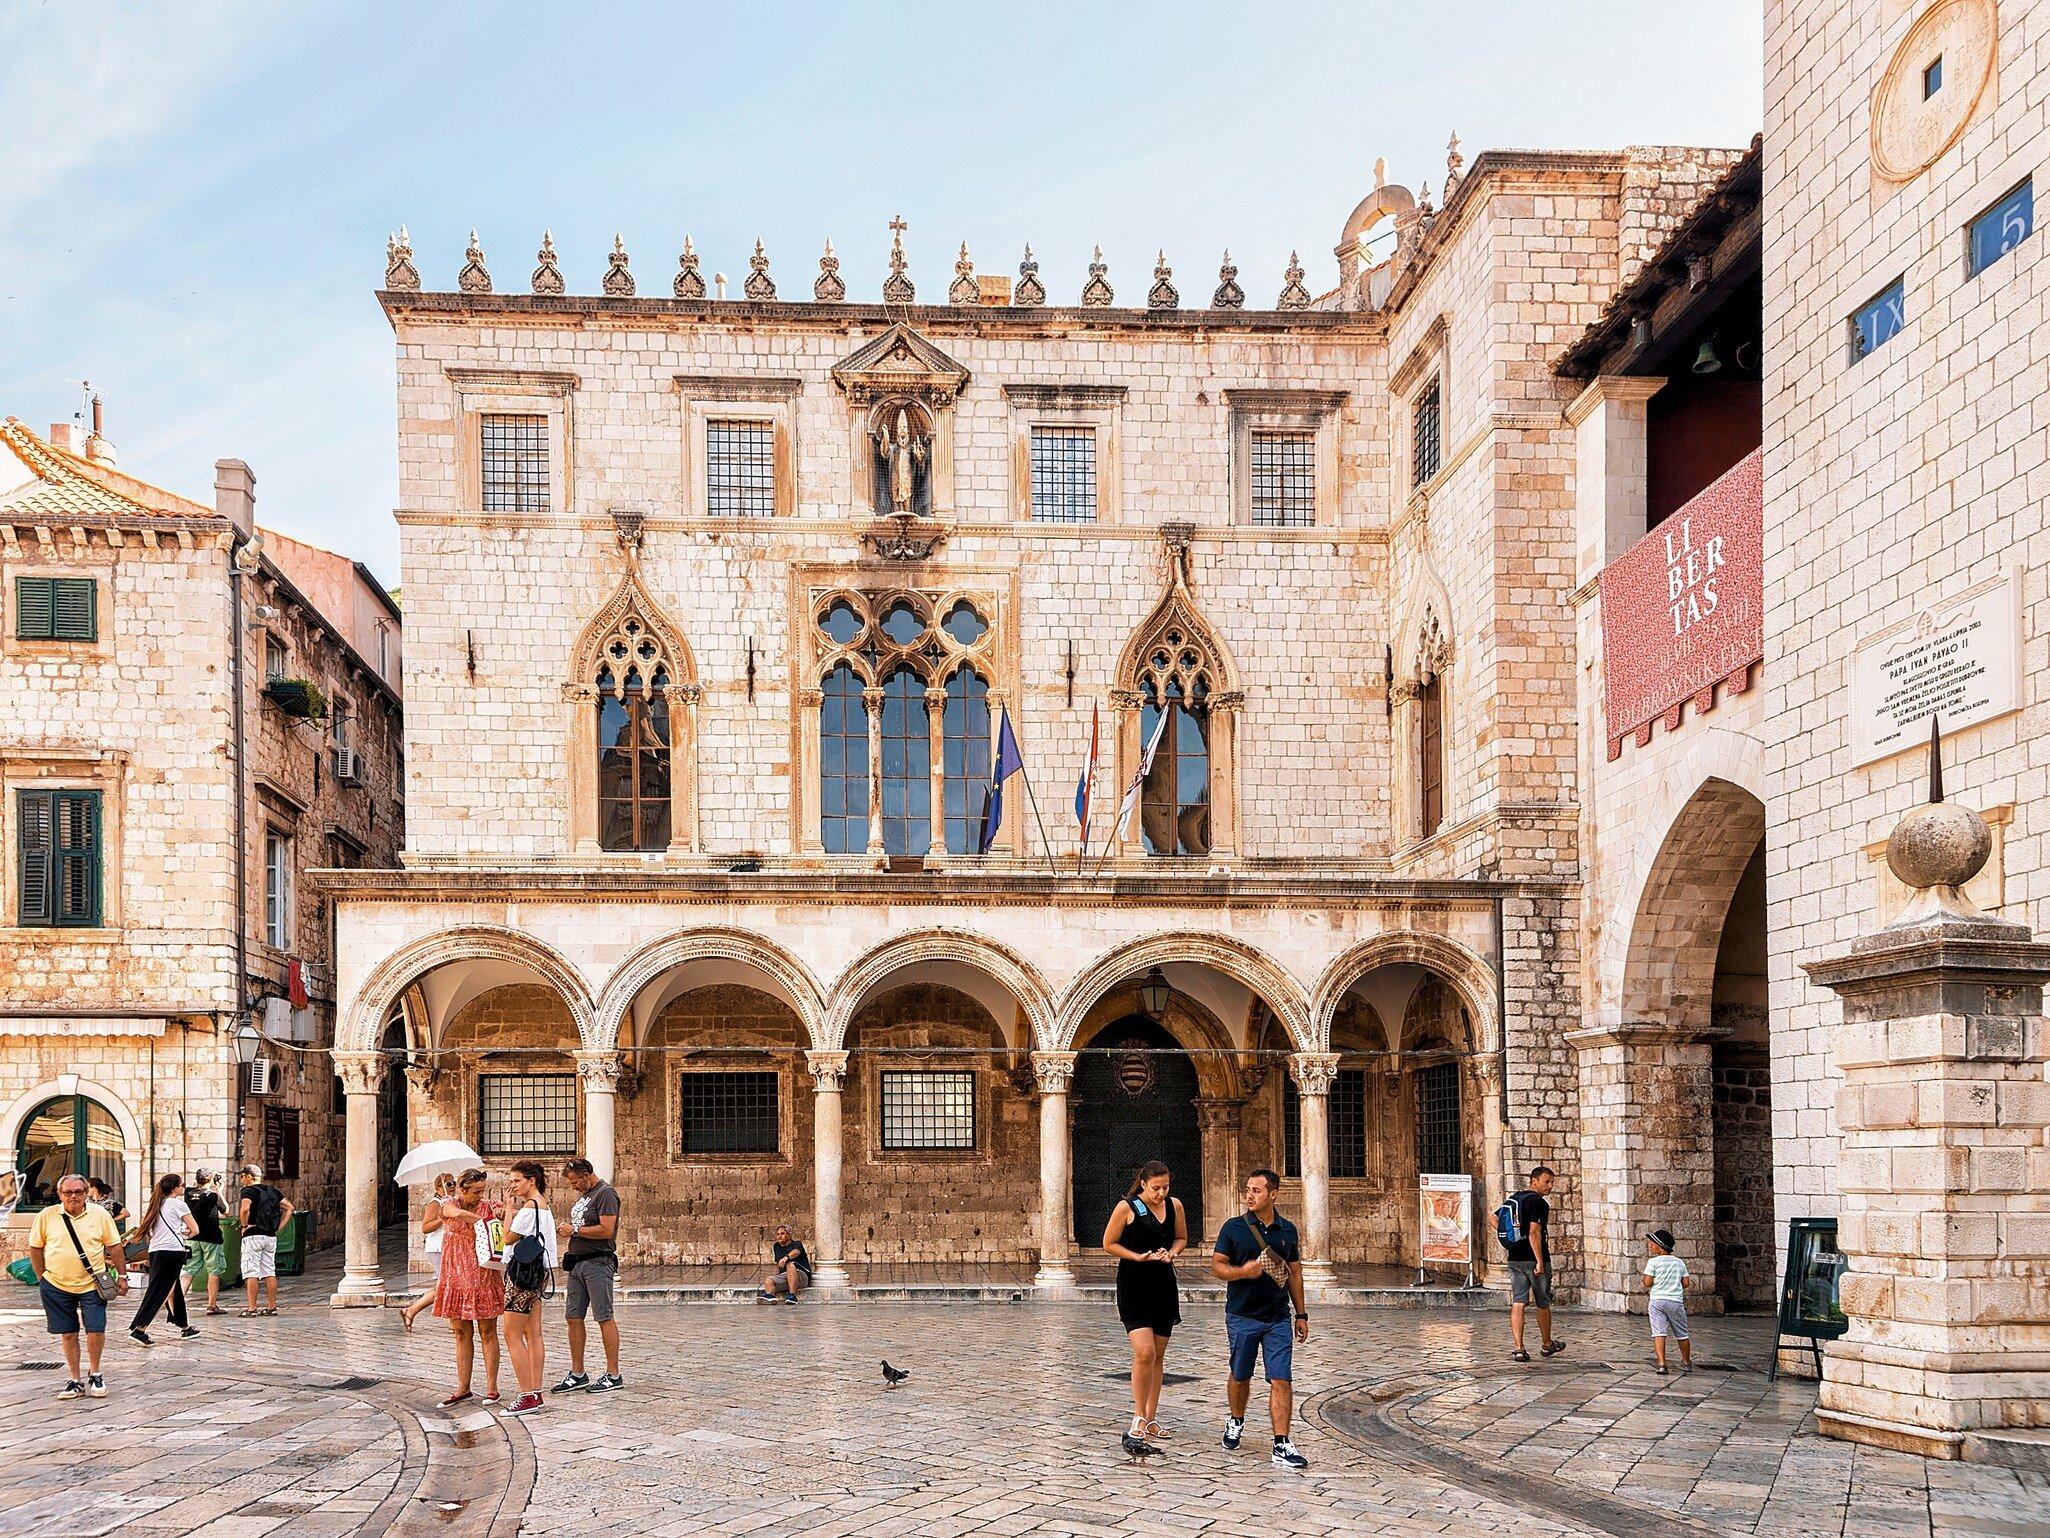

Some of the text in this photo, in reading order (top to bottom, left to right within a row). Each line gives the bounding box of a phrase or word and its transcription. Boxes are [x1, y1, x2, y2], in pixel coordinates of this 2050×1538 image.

[2001, 203, 2025, 254] 5
[1870, 293, 1904, 351] IX
[1664, 518, 1692, 566] LI
[1668, 536, 1726, 602] BER
[1669, 578, 1719, 640] TAS
[1890, 666, 1907, 679] PAPA
[1911, 656, 1928, 670] IVAN
[1932, 644, 1958, 661] PAVAO
